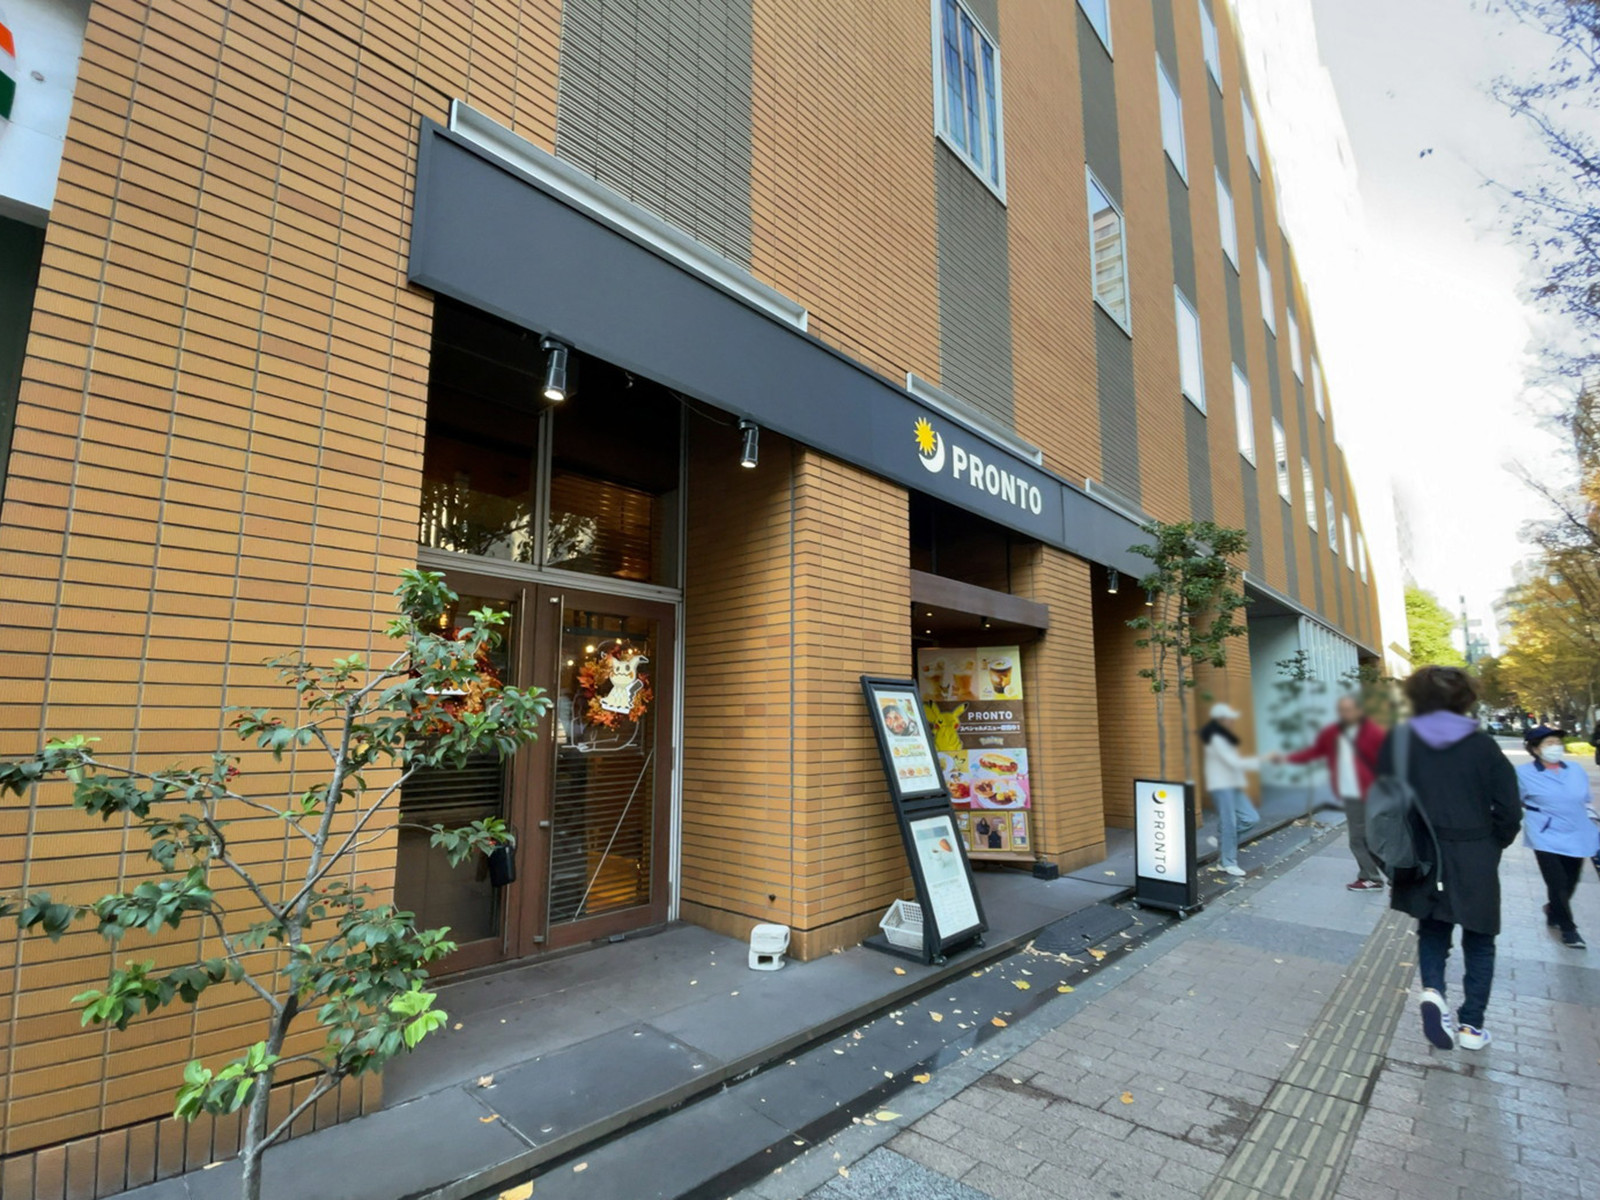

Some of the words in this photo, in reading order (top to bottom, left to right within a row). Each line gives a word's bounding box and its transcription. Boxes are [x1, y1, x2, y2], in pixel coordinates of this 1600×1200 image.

[952, 445, 1042, 515] PRONTO
[968, 711, 1013, 720] PRONTO
[1153, 809, 1167, 875] PRONTO
